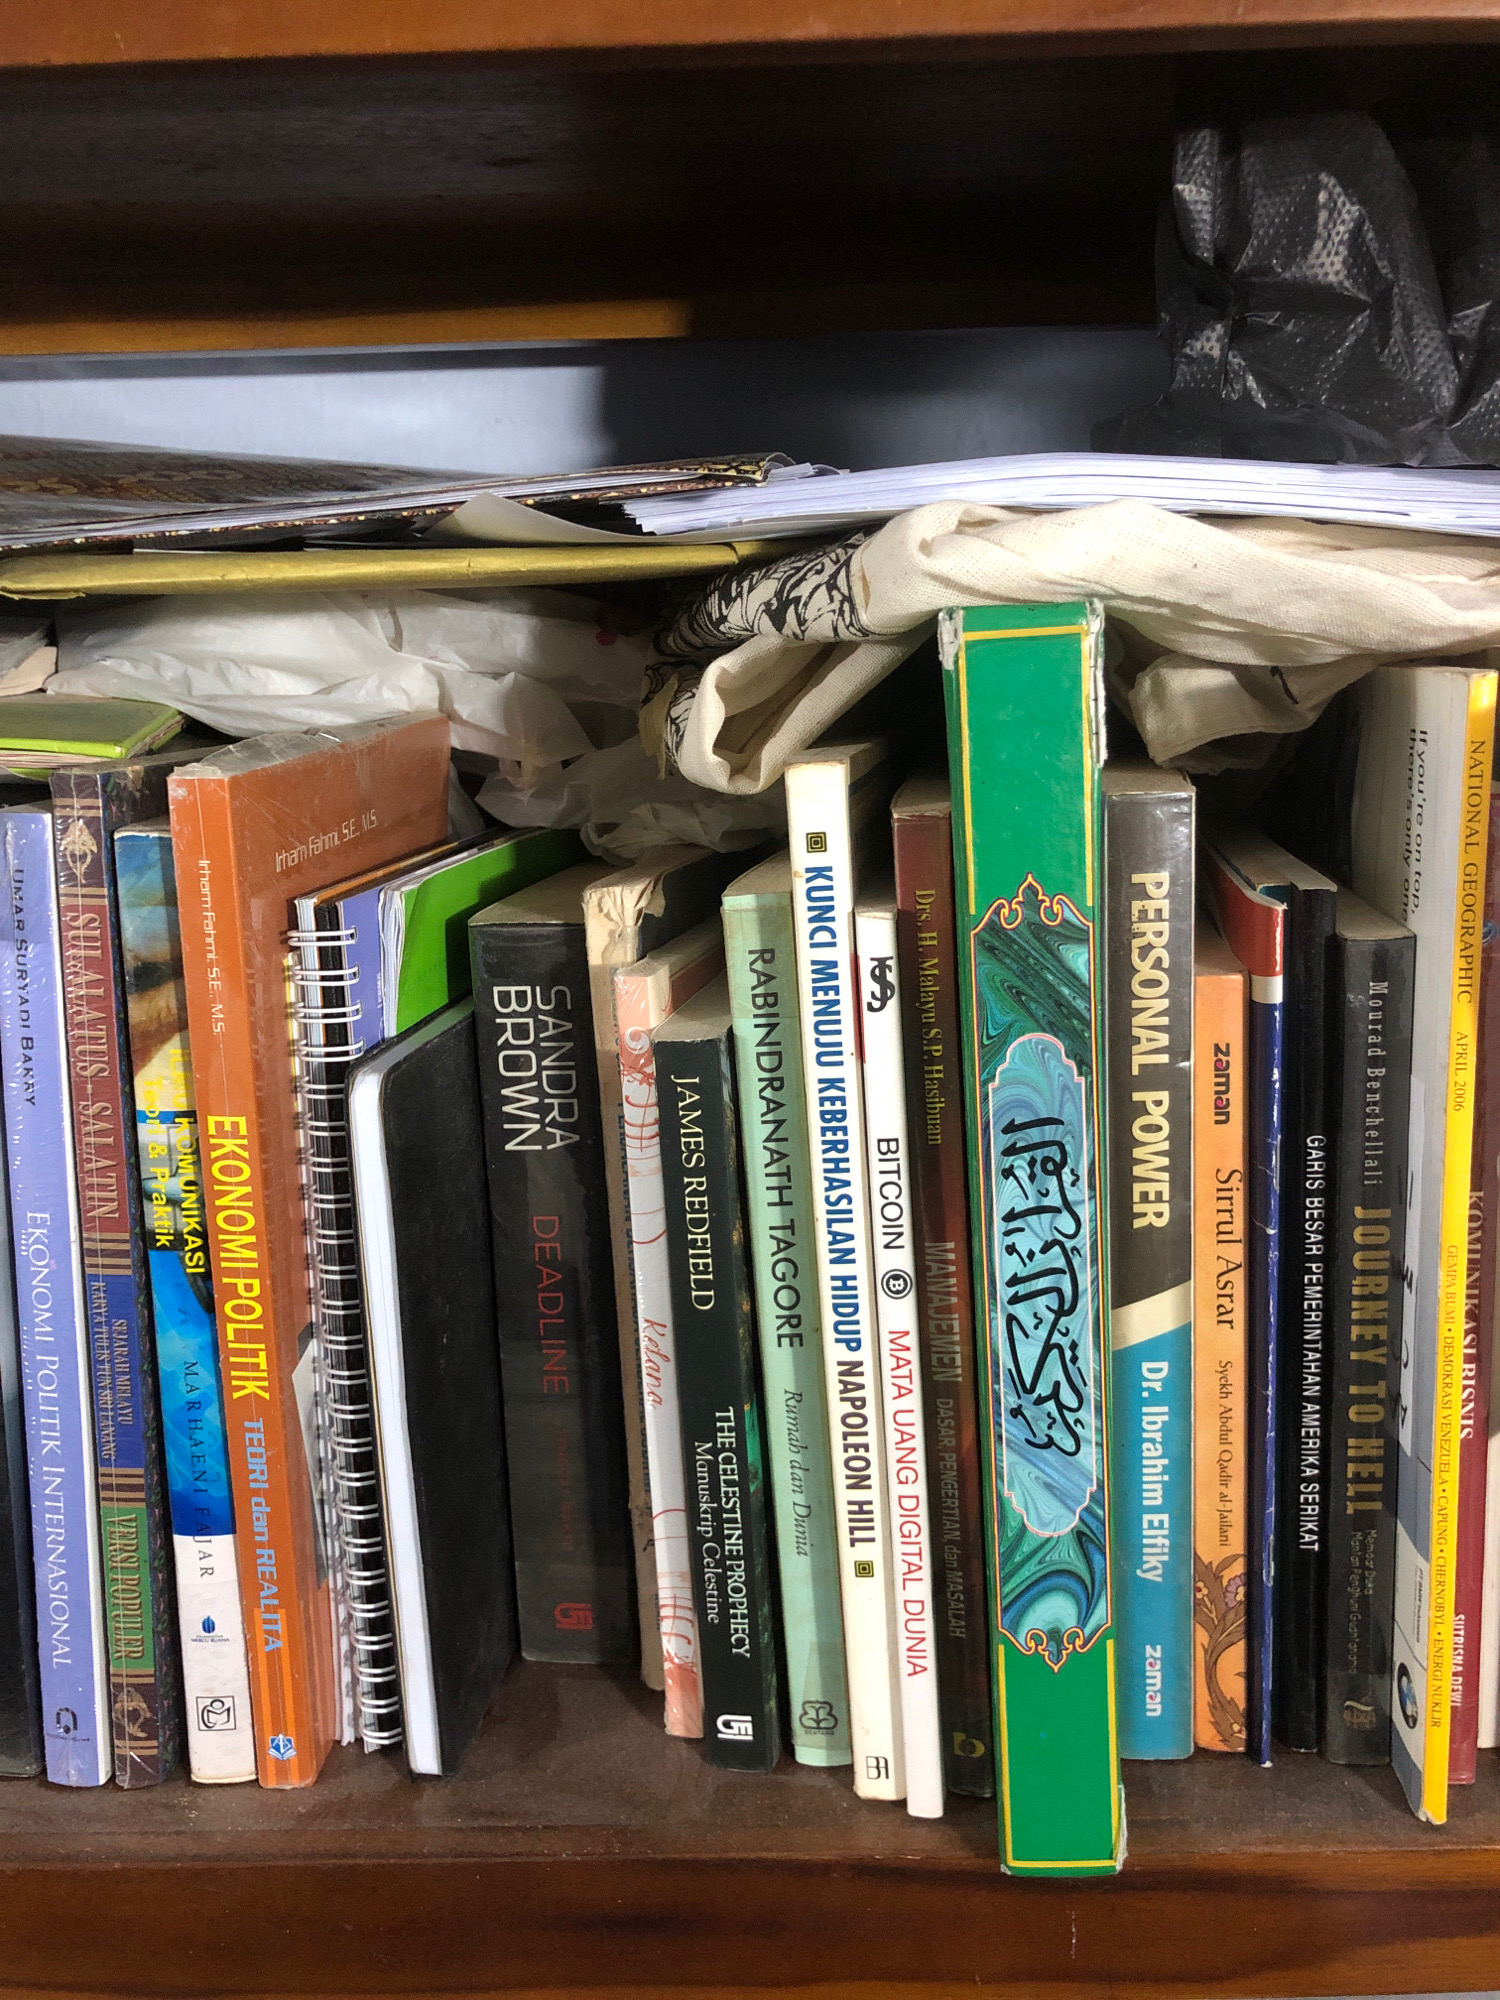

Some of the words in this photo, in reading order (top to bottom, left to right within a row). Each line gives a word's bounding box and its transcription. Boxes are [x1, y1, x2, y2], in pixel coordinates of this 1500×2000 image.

[1406, 728, 1417, 811] there's
[1418, 730, 1428, 746] If
[1415, 750, 1427, 827] you're
[1464, 740, 1486, 854] NATIONAL
[275, 844, 310, 873] Irham
[1402, 817, 1413, 868] only
[1415, 833, 1423, 863] on
[12, 869, 25, 932] UMAR
[198, 860, 211, 910] Irham
[804, 866, 837, 948] KUNCI
[914, 889, 936, 927] Drs.
[1401, 878, 1410, 923] one
[1411, 871, 1422, 915] top,
[916, 931, 938, 952] H.
[1457, 862, 1479, 1004] GEOGRAPHIC
[15, 938, 31, 1029] SURYADI
[916, 957, 940, 1024] Malayu
[1131, 872, 1170, 1076] PERSONAL
[810, 959, 844, 1067] MENUJU
[921, 1028, 943, 1060] S.P.
[1367, 981, 1388, 1056] Mourad
[21, 1036, 36, 1106] BAKRY
[492, 985, 543, 1151] BROWN
[536, 985, 580, 1150] SANDRA
[748, 948, 793, 1207] RABINDRANATH
[1213, 1042, 1231, 1126] zaman
[1454, 1031, 1468, 1076] APRIL
[143, 1076, 166, 1133] Teori
[671, 1075, 706, 1168] JAMES
[924, 1064, 946, 1146] Hasibuan
[1363, 1067, 1386, 1187] Benchellali
[1453, 1080, 1466, 1112] 2006
[79, 1102, 120, 1219] SALATIN
[148, 1143, 167, 1158] &
[817, 1077, 857, 1265] KEBERHASILAN
[1131, 1090, 1171, 1230] POWER
[1306, 1135, 1327, 1190] GARIS
[150, 1167, 175, 1248] Praktik
[174, 1118, 205, 1273] KOMUNIKASI
[206, 1115, 259, 1269] EKONOMI
[877, 1137, 906, 1250] BITCOIN
[1215, 1168, 1243, 1247] Sirrul
[1304, 1198, 1325, 1256] BESAR
[27, 1212, 54, 1342] EKONOMI
[683, 1176, 715, 1311] REDFIELD
[1446, 1245, 1458, 1289] GEMPA
[1462, 1190, 1485, 1356] KOMUNIKASI
[90, 1282, 109, 1323] KARYA
[533, 1215, 570, 1394] DEADLINE
[768, 1219, 803, 1348] TAGORE
[830, 1275, 862, 1352] HIDUP
[924, 1241, 963, 1382] MANAJEMEN
[1216, 1255, 1243, 1330] Asrar
[1350, 1205, 1391, 1365] JOURNEY
[1445, 1292, 1457, 1325] BUMI
[93, 1326, 110, 1361] TULIS
[111, 1319, 130, 1372] SEJARAH
[221, 1277, 270, 1400] POLITIK
[643, 1317, 671, 1410] Kelana
[888, 1330, 914, 1401] MATA
[1302, 1263, 1324, 1397] PEMERINTAHAN
[36, 1355, 61, 1456] POLITIK
[96, 1364, 113, 1387] TUN
[114, 1375, 133, 1425] MELAYU
[1141, 1361, 1169, 1398] Dr.
[1214, 1360, 1233, 1400] Syekh
[1348, 1380, 1386, 1424] TO
[1441, 1336, 1454, 1411] DEMOKRASI
[1459, 1363, 1477, 1440] BISNIS
[99, 1411, 116, 1459] LANANG
[184, 1361, 209, 1494] MARHAENI
[244, 1417, 269, 1489] TEORI
[715, 1406, 736, 1448] THE
[784, 1389, 808, 1455] Rumah
[836, 1360, 872, 1490] NAPOLEON
[892, 1408, 919, 1485] UANG
[936, 1398, 956, 1449] DASAR,
[1141, 1405, 1170, 1507] Ibrahim
[1217, 1404, 1234, 1446] Abdul
[1300, 1403, 1320, 1477] AMERIKA
[1438, 1415, 1451, 1486] VENEZUELA
[694, 1441, 718, 1538] Manuskrip
[717, 1451, 744, 1556] CELESTINE
[789, 1459, 810, 1495] dan
[1215, 1449, 1234, 1489] Qadir
[1346, 1437, 1385, 1515] HELL
[105, 1514, 140, 1574] VERSI
[193, 1506, 214, 1578] FAJAR
[251, 1497, 272, 1542] dan
[793, 1501, 814, 1557] Dunia
[846, 1499, 876, 1548] HILL
[897, 1494, 924, 1591] DIGITAL
[1136, 1513, 1170, 1583] Elfiky
[1215, 1491, 1234, 1548] al-Jailani
[1298, 1482, 1319, 1552] SERIKAT
[1436, 1496, 1448, 1546] CAPUNG
[43, 1466, 72, 1668] INTERNASIONAL
[702, 1541, 721, 1625] Celestine
[944, 1544, 958, 1569] dan
[1433, 1556, 1446, 1629] CHERNOBYL
[110, 1576, 144, 1661] POPULER
[256, 1548, 283, 1652] REALITA
[726, 1560, 750, 1658] PROPHECY
[946, 1571, 967, 1640] MASALAH
[903, 1599, 929, 1678] DUNIA
[1432, 1638, 1444, 1681] ENERGI
[1451, 1614, 1465, 1674] SUTRISNA
[1144, 1644, 1162, 1717] zaman
[1430, 1683, 1441, 1728] NUKLIR
[1450, 1675, 1463, 1707] DEWI
